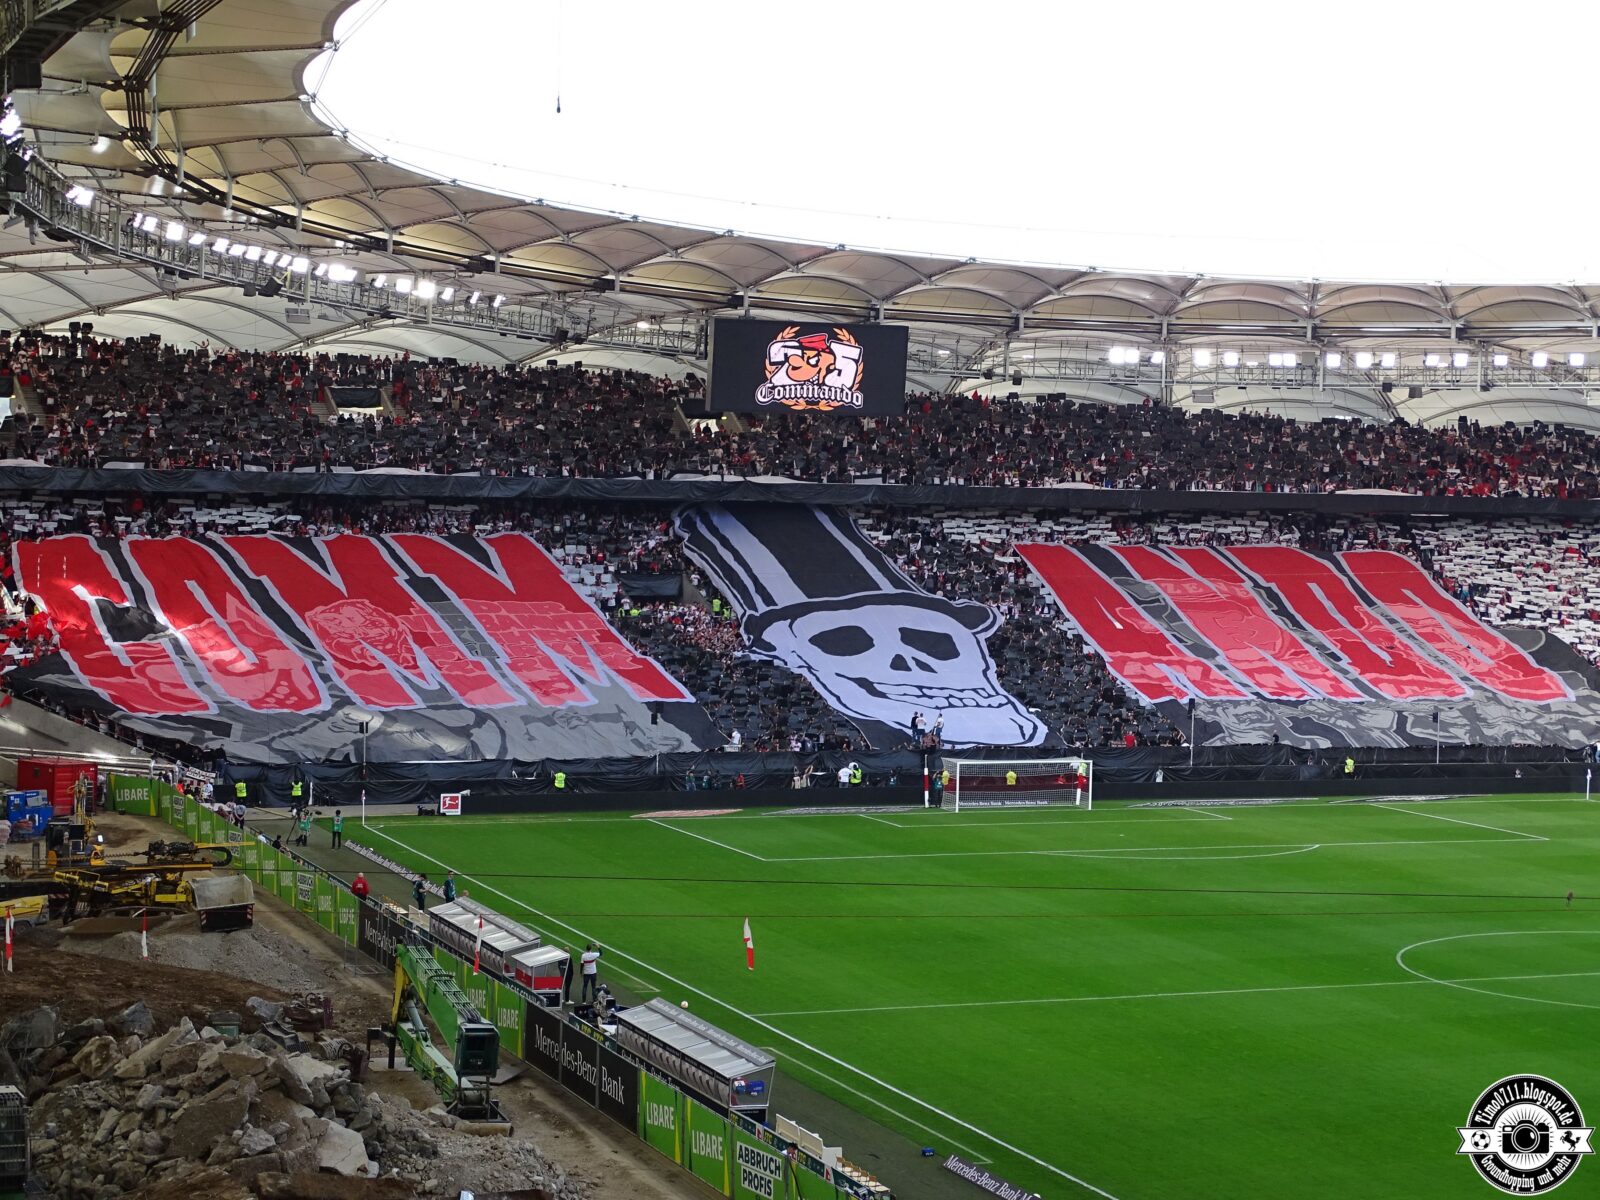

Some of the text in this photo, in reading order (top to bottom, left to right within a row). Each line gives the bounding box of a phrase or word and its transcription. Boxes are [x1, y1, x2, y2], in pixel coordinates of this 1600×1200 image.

[756, 382, 864, 409] Commando
[116, 788, 149, 801] LIBARE
[497, 1007, 519, 1030] LIBARE
[534, 1024, 597, 1086] Mercedes-Benz
[601, 1065, 625, 1105] Bank
[646, 1101, 675, 1130] LIBARE
[691, 1129, 724, 1161] LIBARE
[738, 1144, 782, 1178] ABBRUCH
[742, 1167, 772, 1197] PROFIS
[943, 1154, 1021, 1200] Mercedes-Benz Bank
